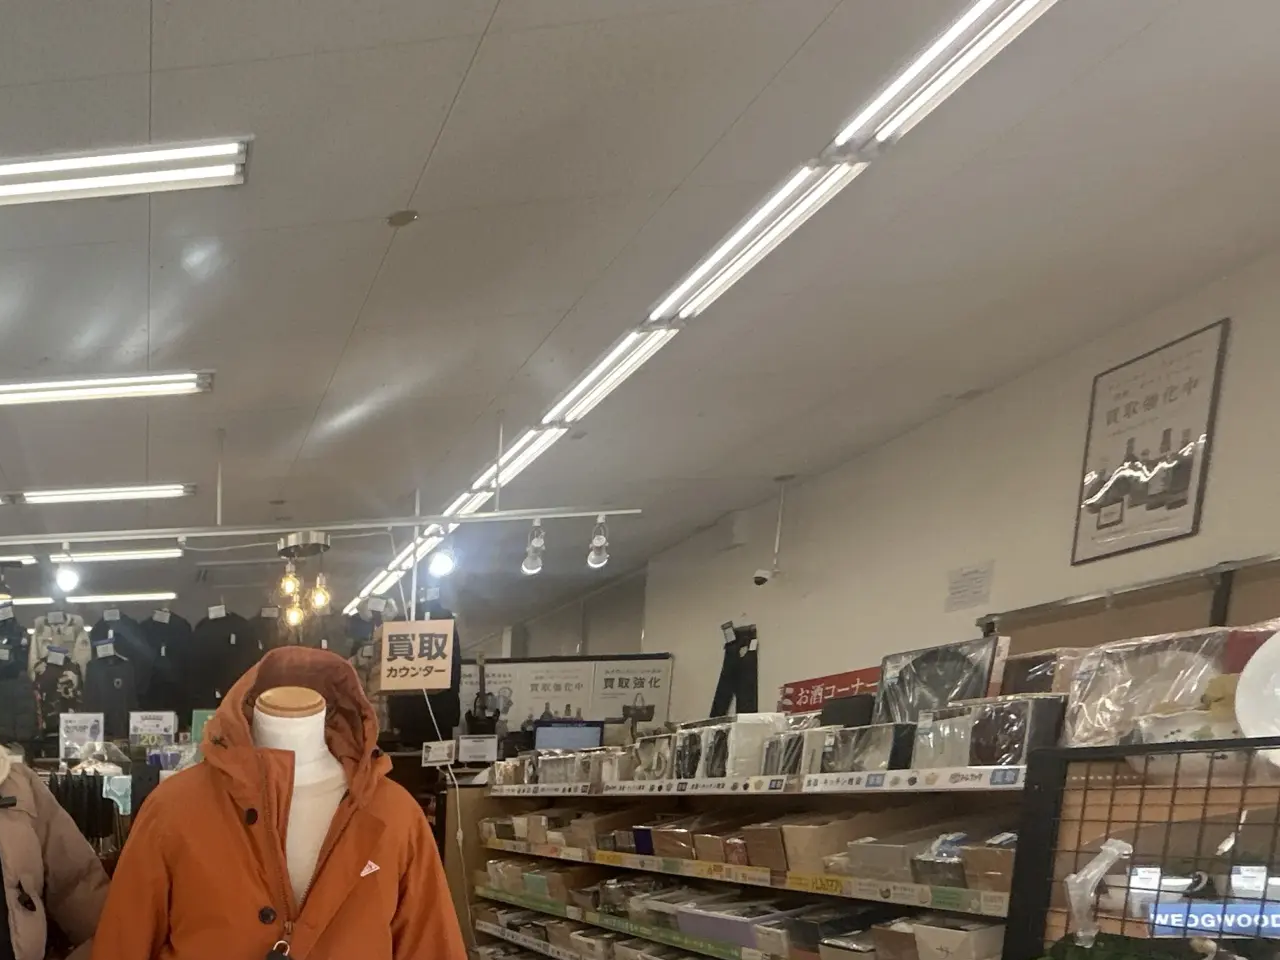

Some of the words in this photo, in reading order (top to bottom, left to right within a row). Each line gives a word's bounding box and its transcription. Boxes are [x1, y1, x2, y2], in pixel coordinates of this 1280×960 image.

[386, 632, 448, 661] 買取
[386, 665, 446, 678] カウンター
[603, 675, 661, 690] 買取強化
[796, 678, 878, 706] お酒コーナー
